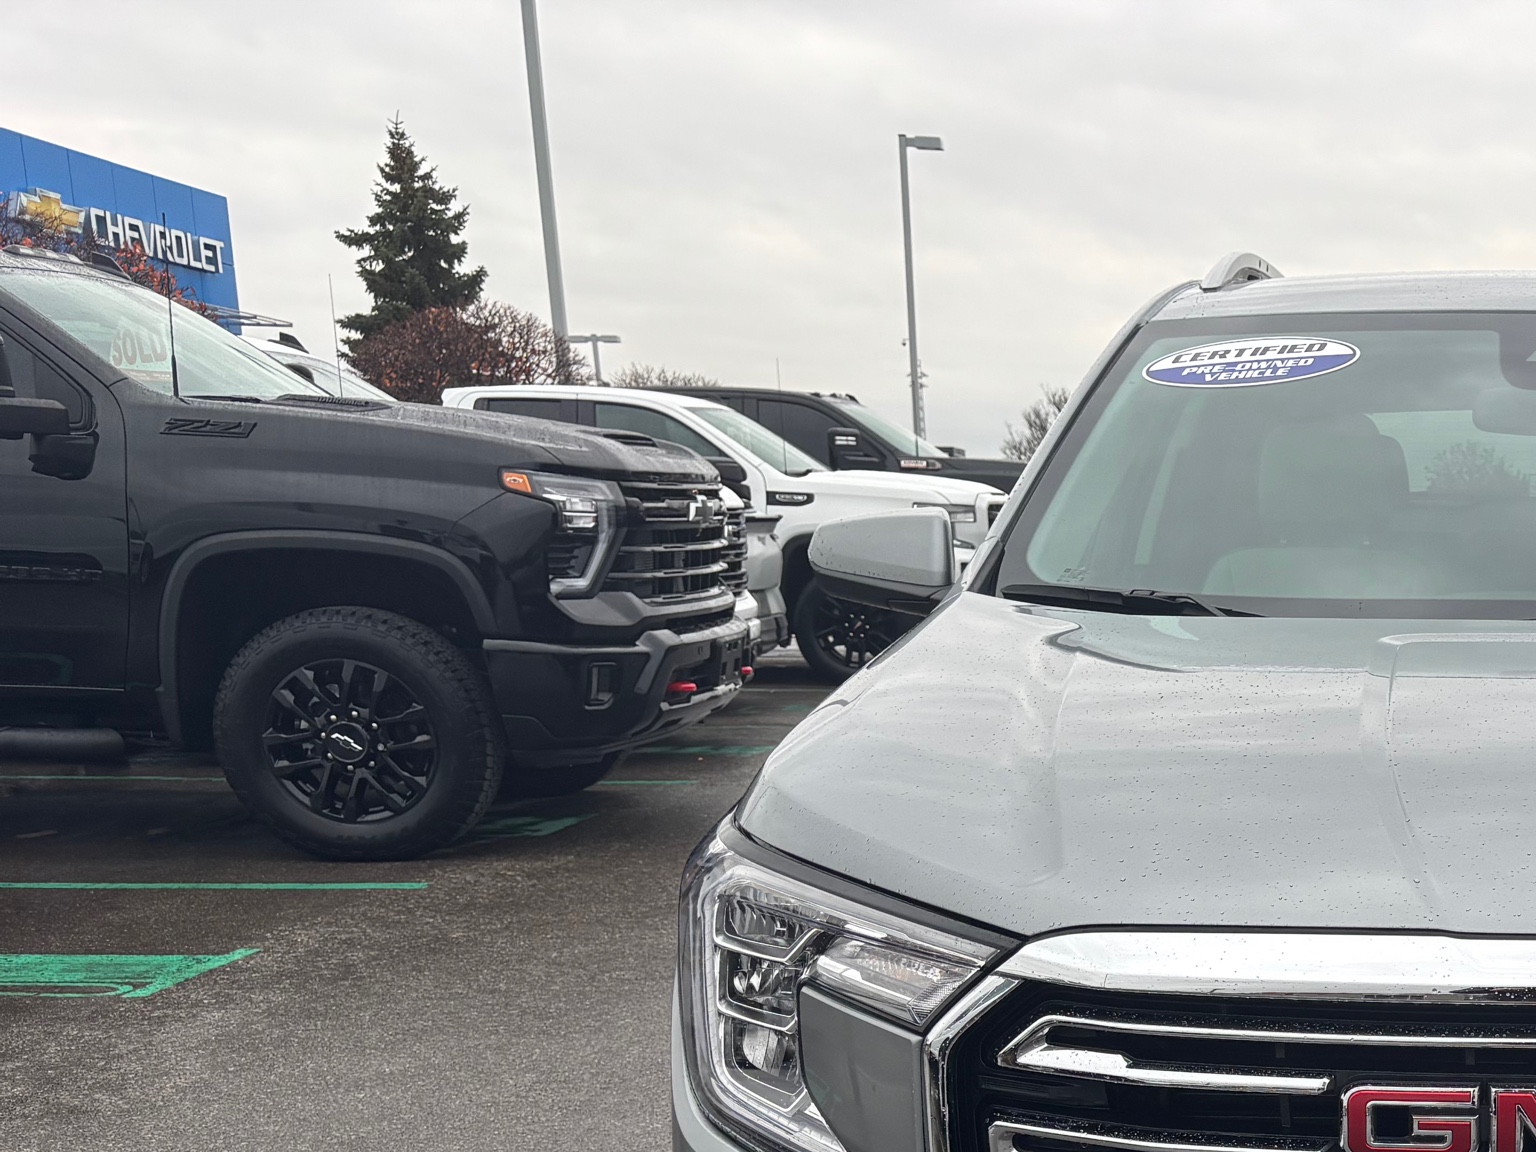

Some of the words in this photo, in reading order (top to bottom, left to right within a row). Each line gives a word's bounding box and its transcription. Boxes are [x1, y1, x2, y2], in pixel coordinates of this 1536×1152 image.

[89, 207, 224, 274] CHEVROLET
[111, 329, 168, 367] SOLD
[1171, 342, 1328, 364] CERTIFIED
[1181, 358, 1315, 376] PRE-OWNED
[1204, 366, 1291, 382] VEHICLE
